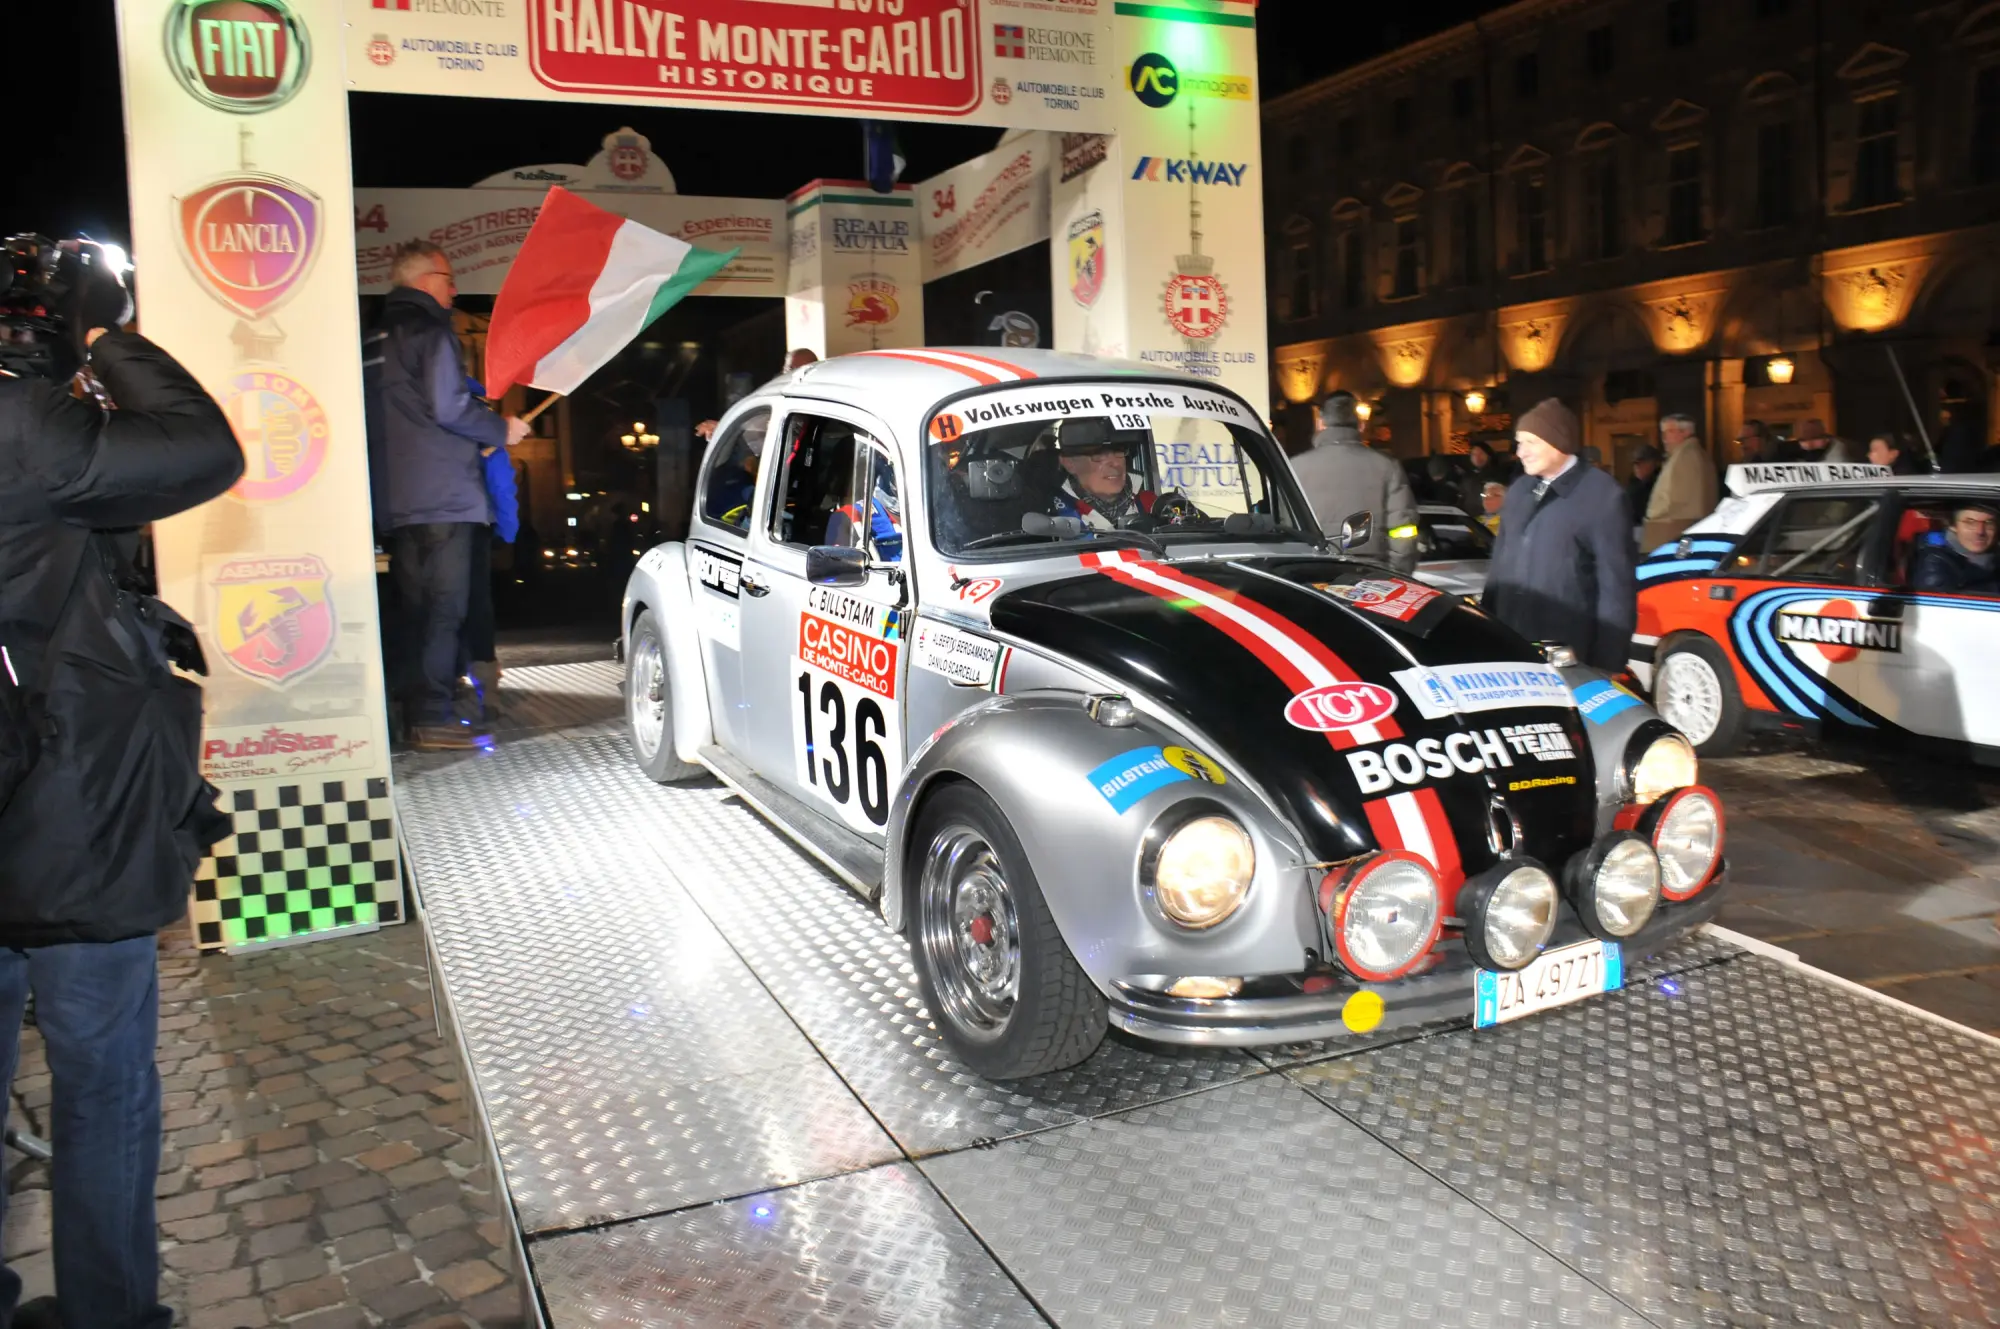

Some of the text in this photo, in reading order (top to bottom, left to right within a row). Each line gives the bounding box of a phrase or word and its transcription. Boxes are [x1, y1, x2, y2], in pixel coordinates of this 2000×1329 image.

[416, 0, 505, 17] PIEMONTE
[401, 38, 518, 57] AUTOMOBILE CLUB
[546, 0, 966, 80] RALLYE MONTE-CARLO
[1028, 27, 1095, 49] REGIONE
[199, 19, 280, 78] FIAT
[1028, 46, 1096, 65] PIEMONTE
[437, 56, 484, 71] TORINO
[659, 64, 874, 97] HISTORIQUE
[1017, 81, 1105, 99] AUTOMOBILE CLUB
[1044, 97, 1080, 110] TORINO
[833, 218, 909, 236] REALE
[207, 222, 296, 253] LANCIA
[833, 233, 909, 250] MUTUA
[848, 279, 900, 296] DERBY
[1140, 350, 1256, 364] AUTOMOBILE CLUB
[964, 393, 1239, 424] Volkswagen Porsche Austria
[937, 415, 957, 438] H
[1115, 413, 1145, 428] 136
[1744, 465, 1893, 484] MARTINI RACING
[220, 562, 318, 580] ABARTH
[820, 590, 875, 629] BILLSTAM
[1781, 615, 1898, 649] MARTINI
[804, 618, 890, 676] CASINO
[956, 640, 997, 663] BERGAMASCHI
[803, 647, 889, 693] DE MONTE-CARLO
[928, 654, 981, 682] DANILO SCARCELLA
[1451, 671, 1566, 690] NIINIVIRTA
[1465, 689, 1526, 702] TRANSPORT
[1500, 722, 1563, 737] RACING
[798, 671, 888, 827] 136
[1505, 733, 1573, 755] TEAM
[204, 760, 254, 770] PALCHI
[1346, 728, 1514, 794] BOSCH
[1533, 750, 1577, 761] VIENNA
[204, 768, 278, 780] PARTENZA
[1100, 758, 1170, 798] BILSTEIN
[1500, 972, 1525, 1010] ZA
